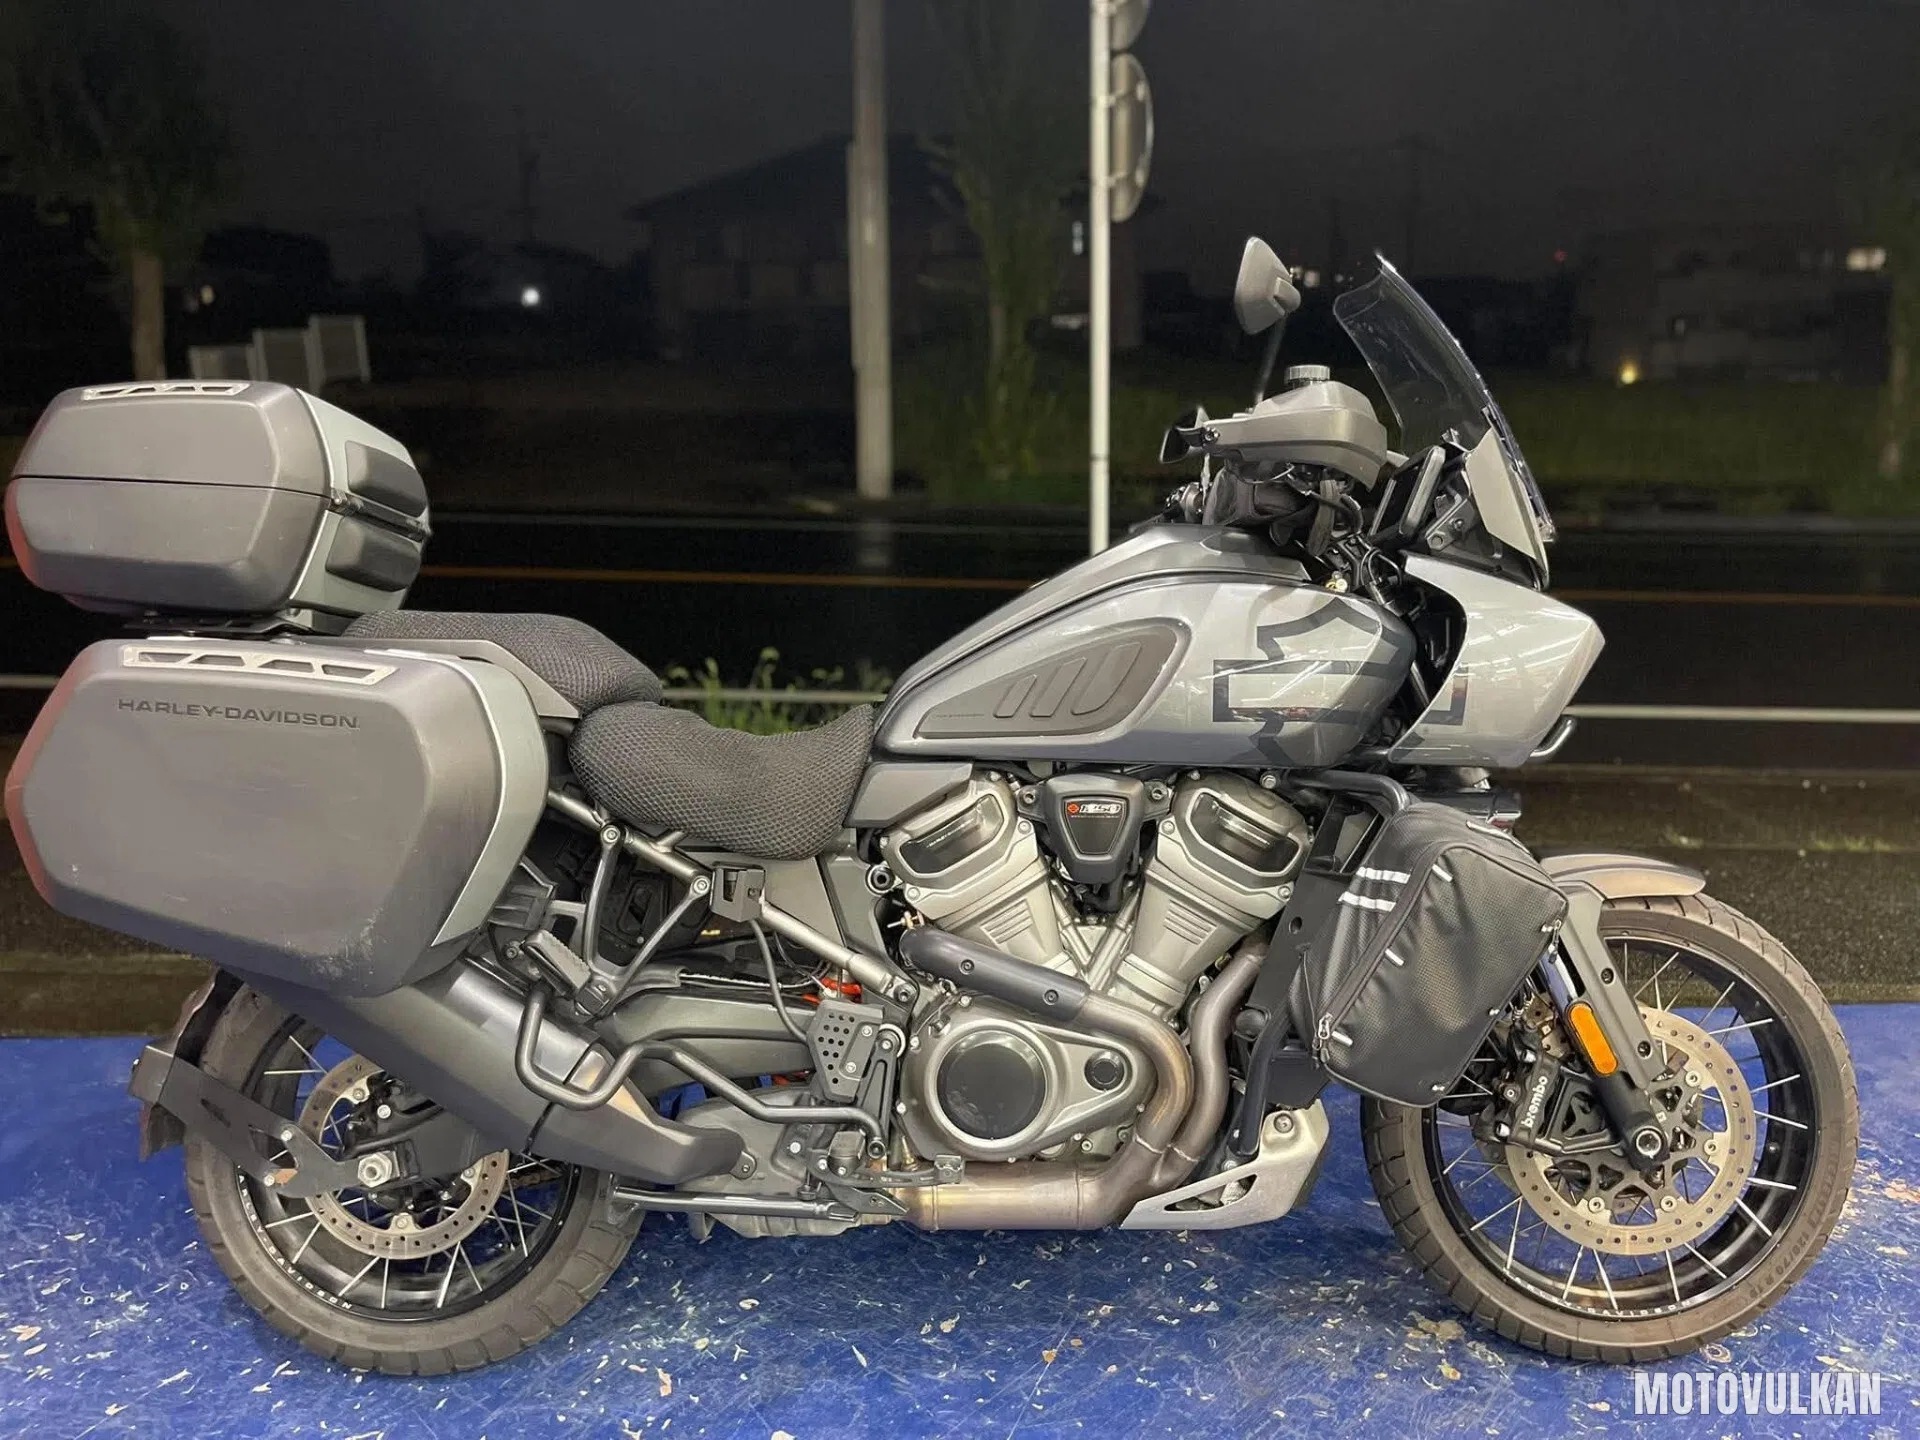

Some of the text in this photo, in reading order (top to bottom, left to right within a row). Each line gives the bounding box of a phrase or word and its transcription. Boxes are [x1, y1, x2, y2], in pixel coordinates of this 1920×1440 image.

[118, 699, 357, 728] HARLEY-DAVIDSON
[1520, 1075, 1548, 1128] brembo
[238, 1165, 353, 1310] ARLEY-DAVIDSON
